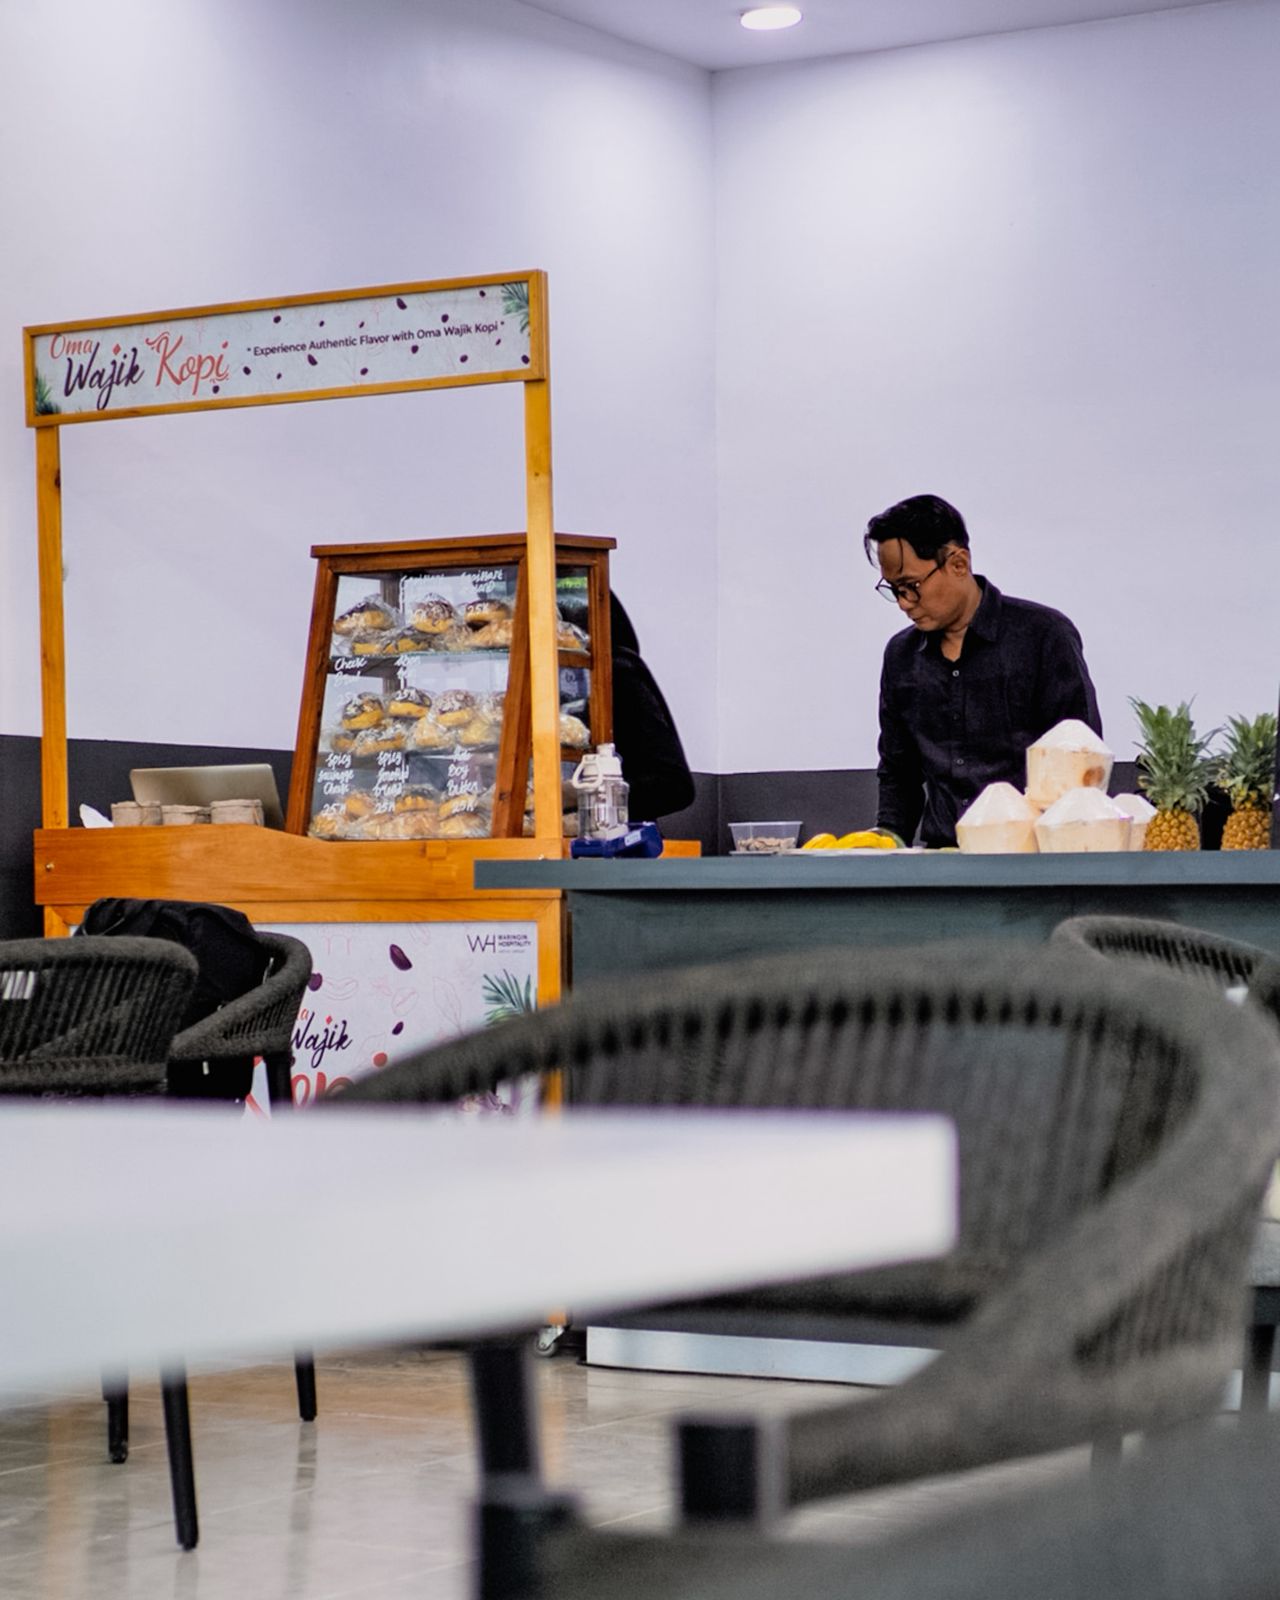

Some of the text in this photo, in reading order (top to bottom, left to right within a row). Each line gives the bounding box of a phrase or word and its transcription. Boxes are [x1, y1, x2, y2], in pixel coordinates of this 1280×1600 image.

[50, 333, 93, 359] Oma
[309, 336, 357, 350] Authentic
[360, 334, 389, 345] Flavor
[392, 329, 414, 342] with
[417, 328, 441, 339] Oma
[444, 324, 472, 338] Wajik
[64, 331, 229, 411] Wajik Kopi
